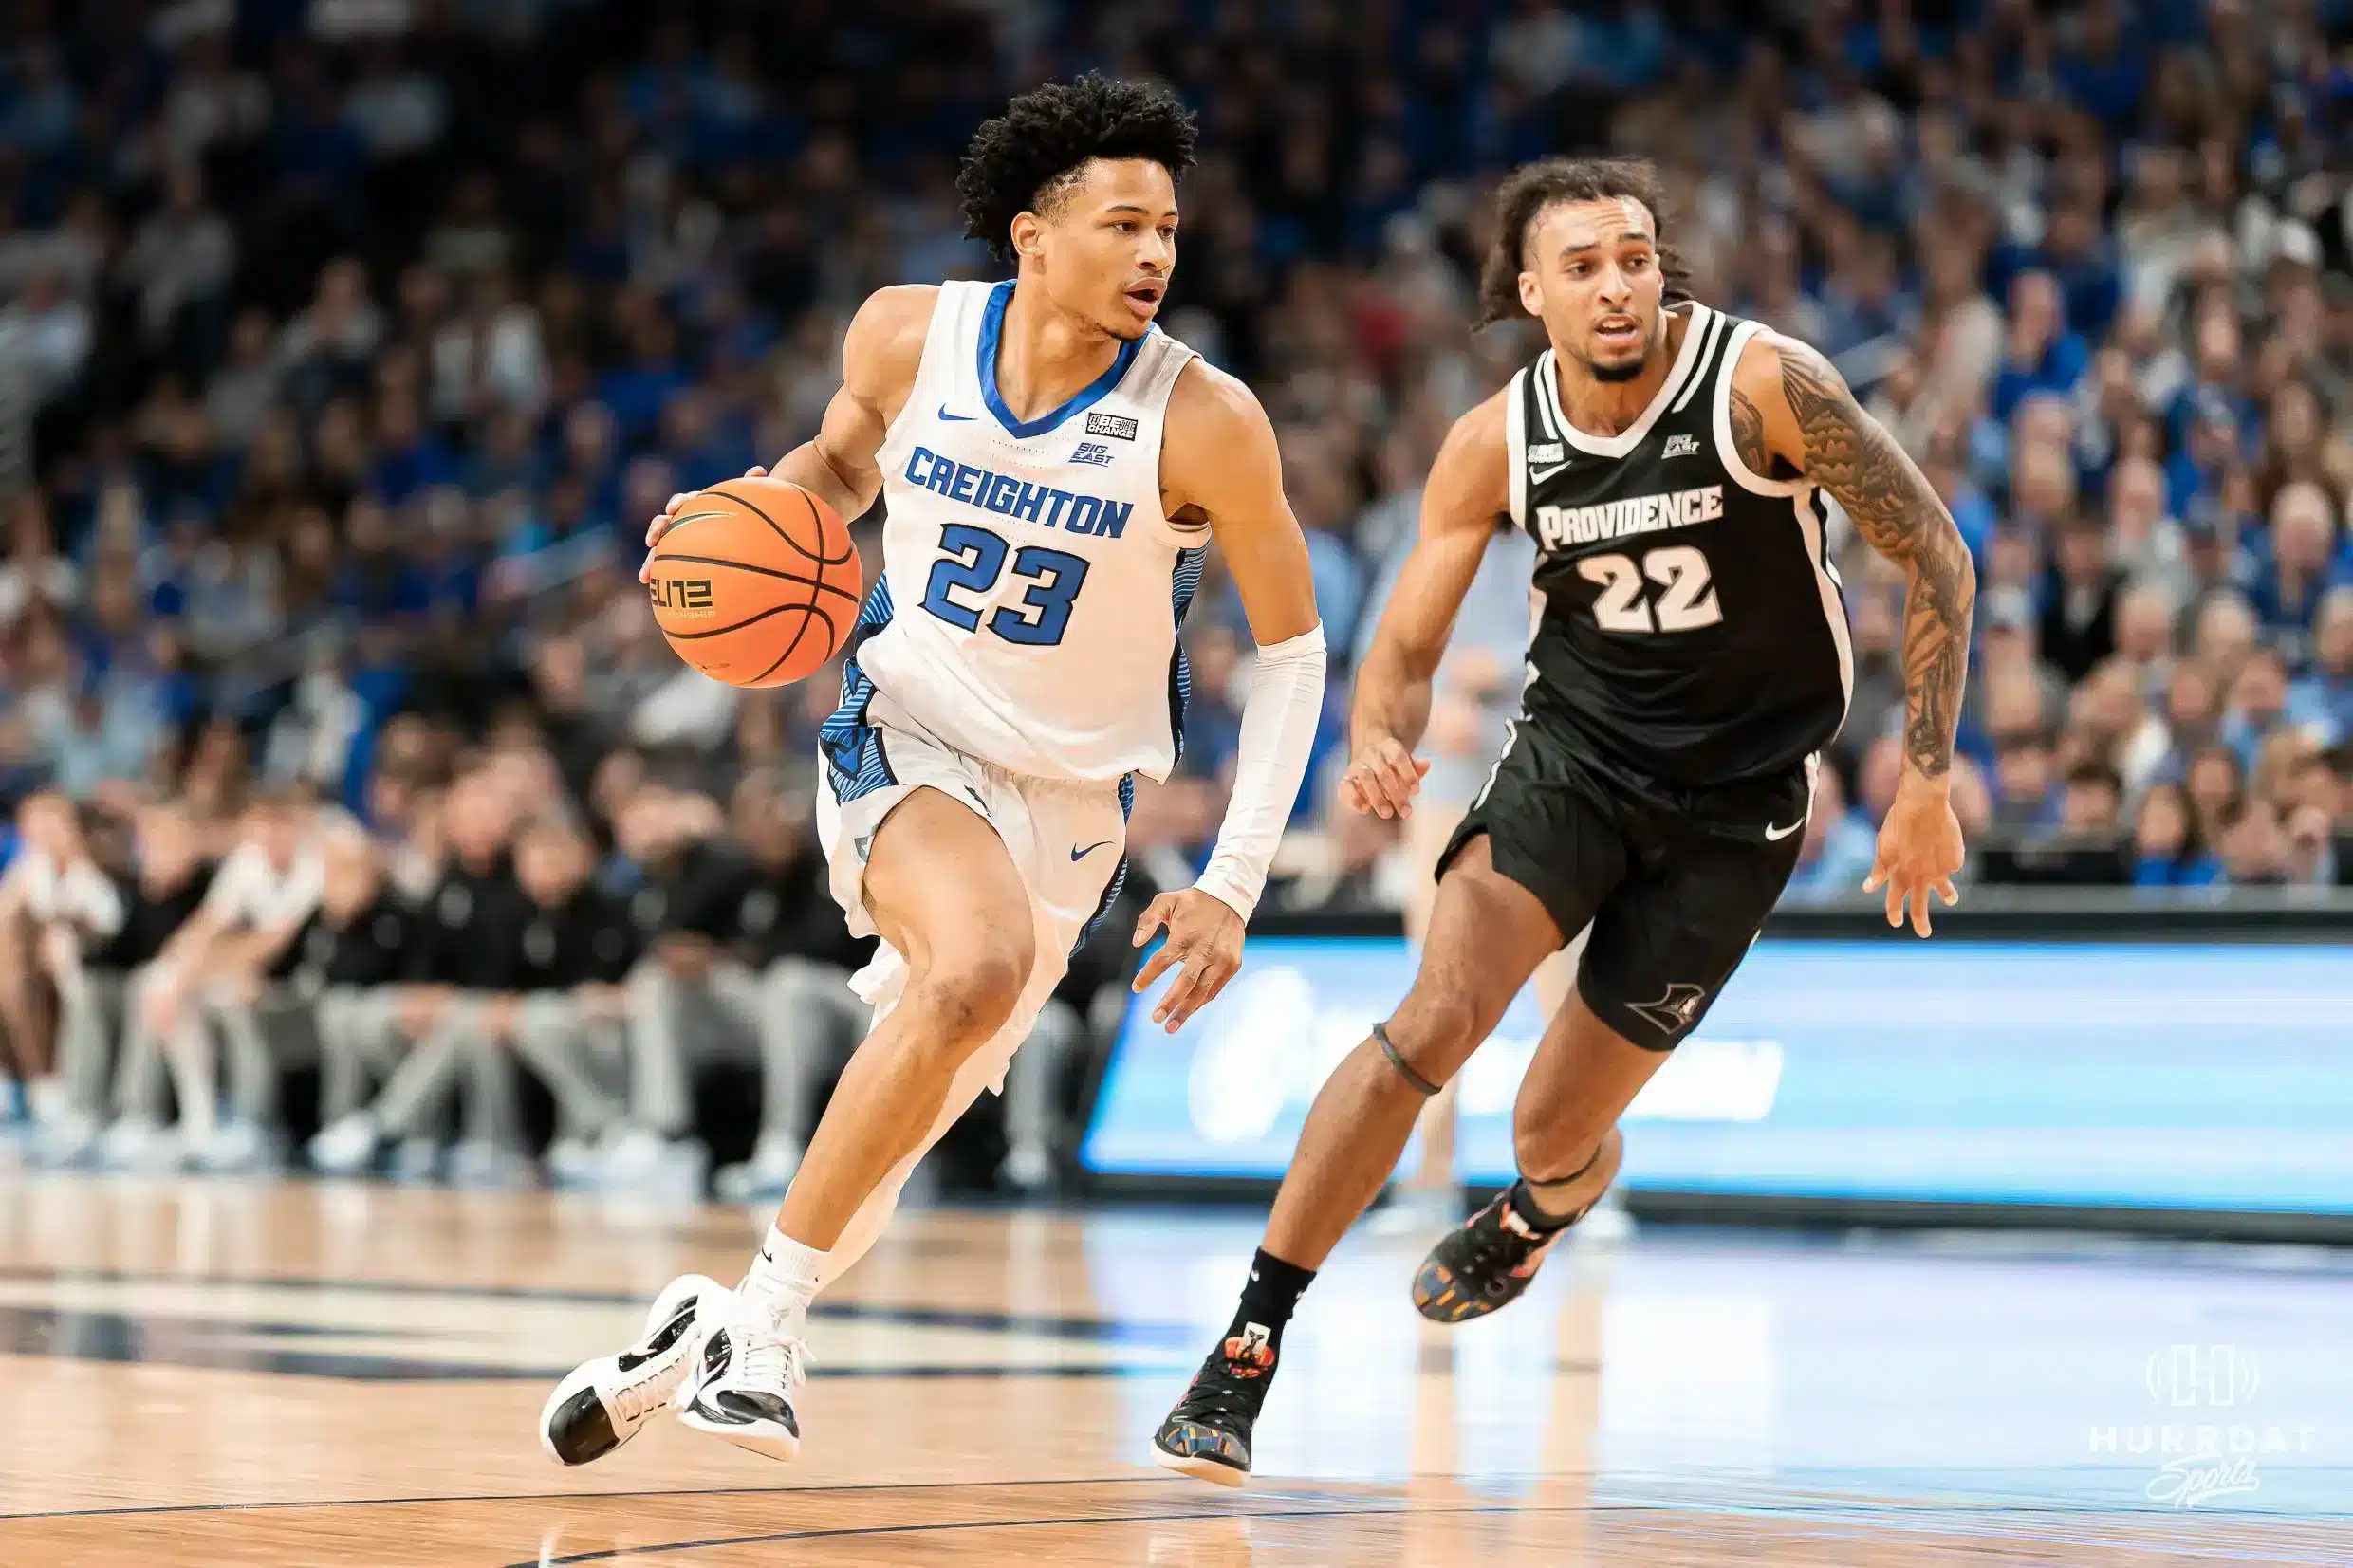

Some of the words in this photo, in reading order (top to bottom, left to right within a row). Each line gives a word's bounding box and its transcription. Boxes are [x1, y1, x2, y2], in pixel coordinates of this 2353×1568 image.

[1071, 451, 1115, 464] EAST
[1077, 442, 1108, 453] BIG
[1087, 425, 1135, 438] CHANGE
[904, 446, 1134, 539] CREIGHTON
[1535, 484, 1723, 551] PROVIDENCE
[917, 523, 1090, 646] 23
[1576, 544, 1723, 633] 22
